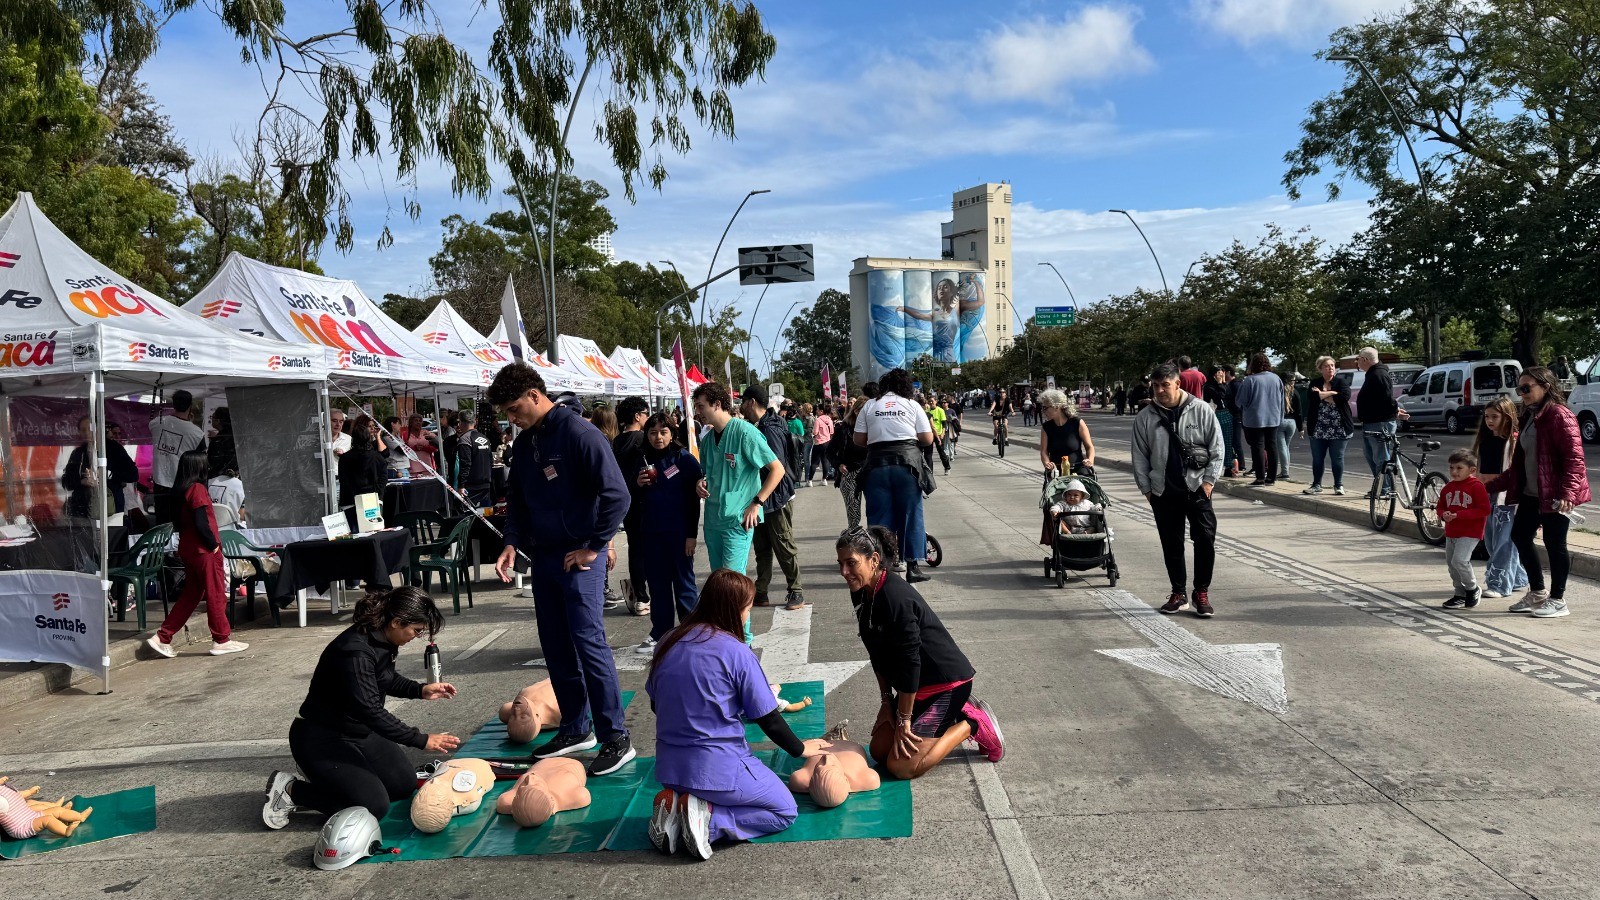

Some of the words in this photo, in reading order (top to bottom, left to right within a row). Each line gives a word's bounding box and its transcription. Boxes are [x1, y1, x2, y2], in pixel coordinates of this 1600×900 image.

[65, 275, 112, 290] Sant
[1, 289, 42, 309] Fe
[4, 333, 33, 342] Santa
[34, 331, 47, 341] Fe
[148, 343, 177, 359] Santa
[178, 348, 190, 361] Fe
[351, 351, 371, 366] Santa
[373, 354, 382, 368] Fe
[281, 356, 302, 368] Santa
[303, 356, 311, 368] Fe
[1445, 490, 1473, 508] GAP
[35, 614, 74, 632] Santa
[75, 618, 87, 634] Fe
